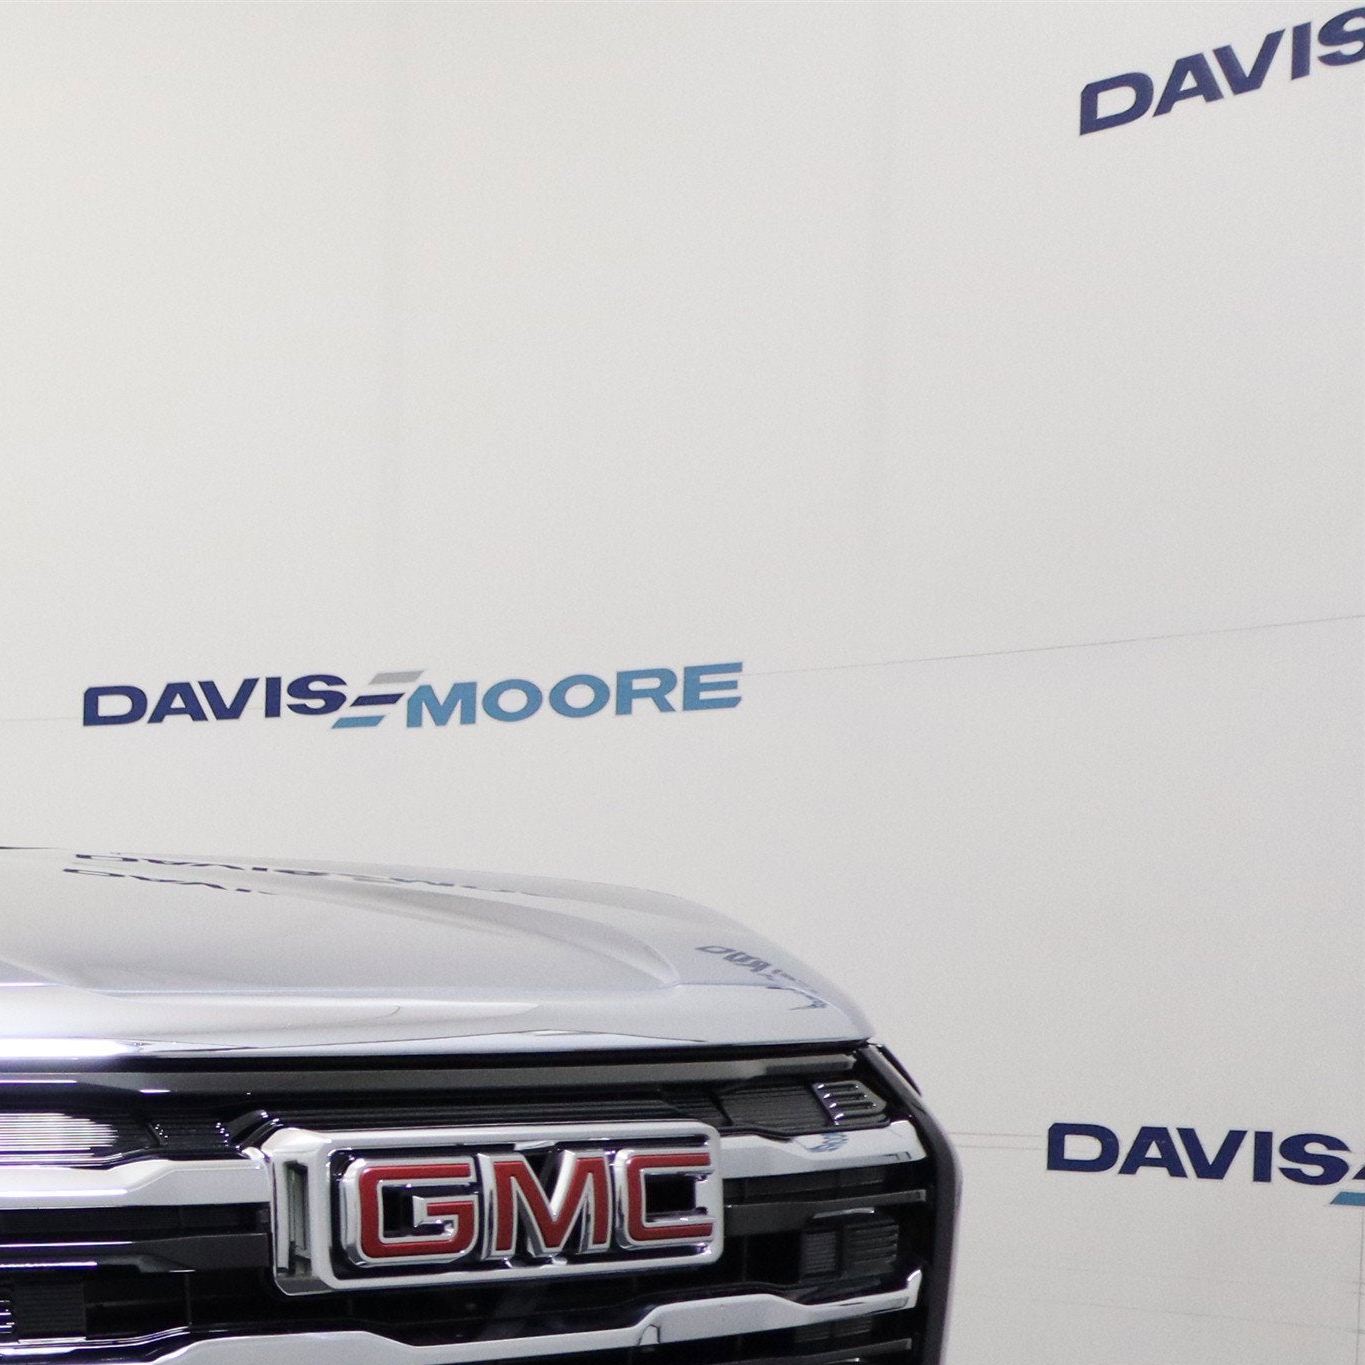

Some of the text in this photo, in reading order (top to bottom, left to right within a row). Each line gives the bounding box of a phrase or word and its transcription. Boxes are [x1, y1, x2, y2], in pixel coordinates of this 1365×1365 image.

[1078, 5, 1365, 137] DAVIS
[81, 660, 744, 730] DAVIS MOORE
[1044, 1120, 1354, 1188] DAVIS
[343, 1148, 716, 1267] GMC
